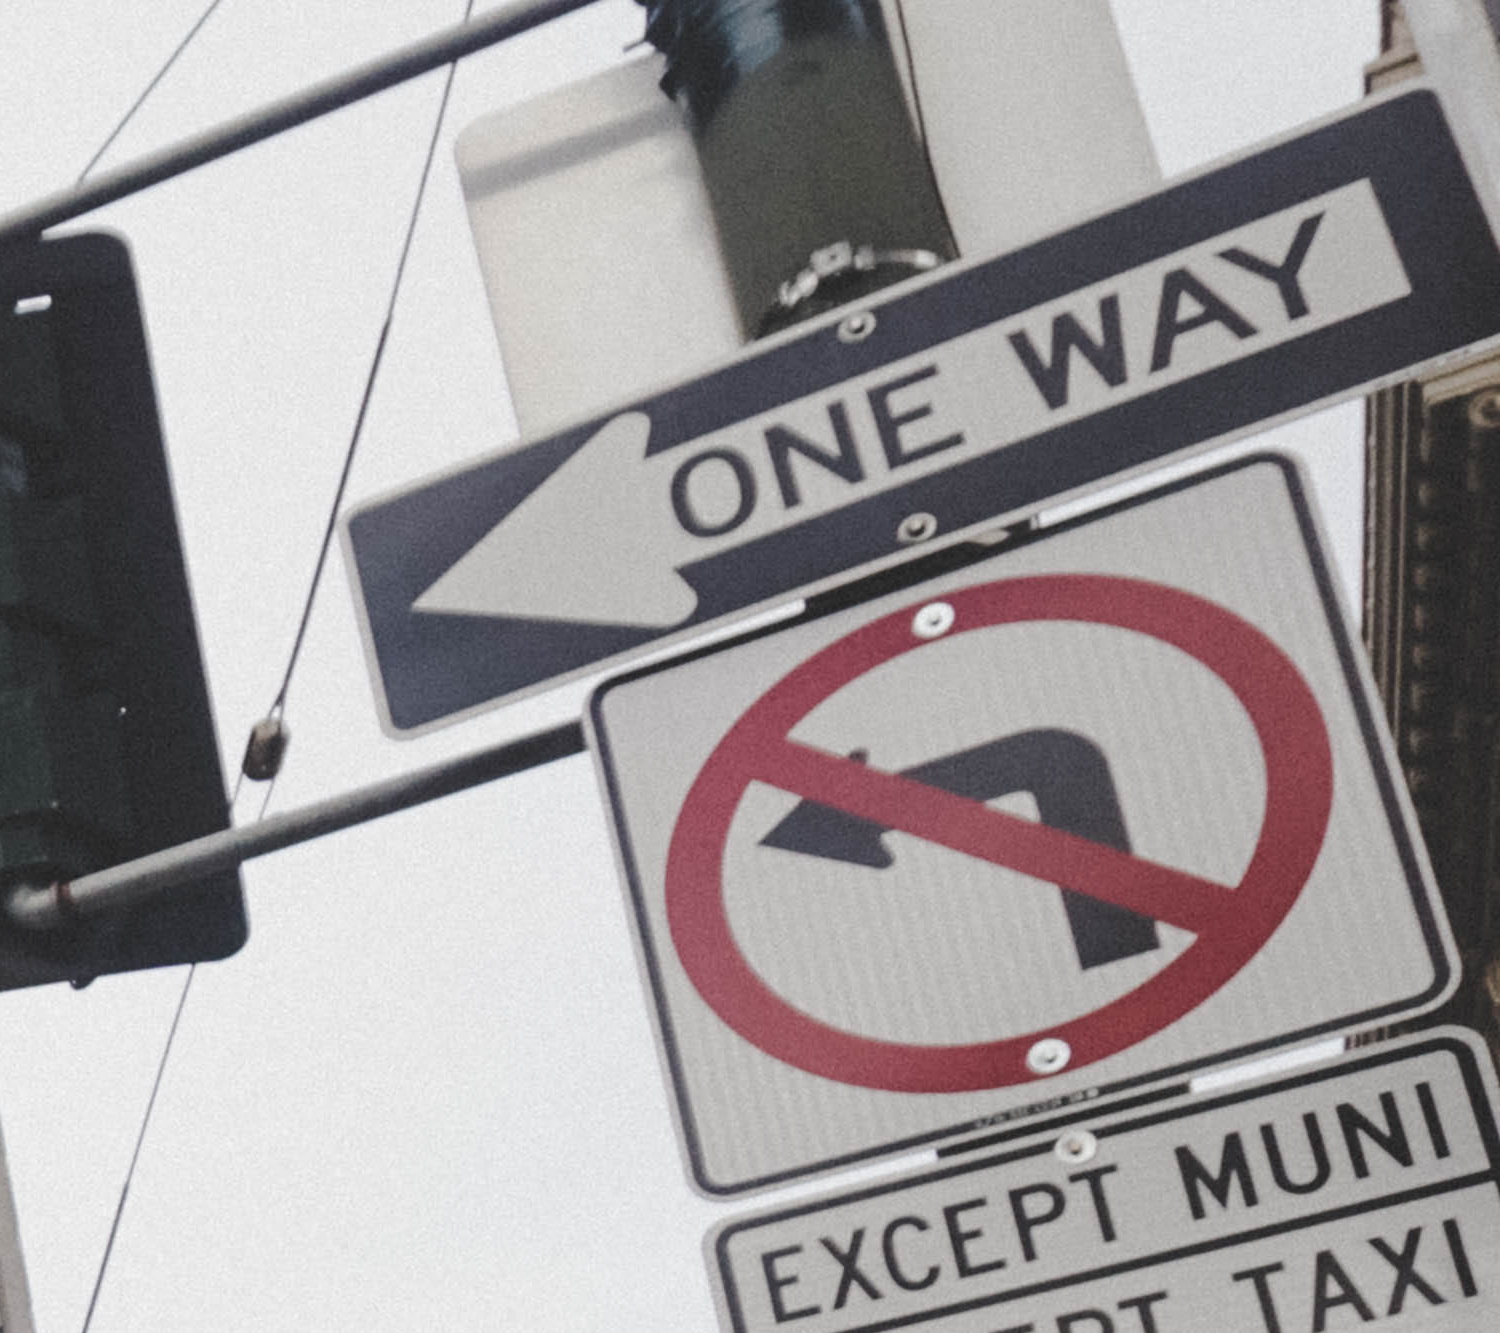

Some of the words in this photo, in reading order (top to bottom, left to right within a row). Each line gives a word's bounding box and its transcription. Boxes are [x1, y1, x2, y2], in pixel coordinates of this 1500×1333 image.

[671, 366, 966, 540] ONE
[1008, 212, 1329, 411] WAY
[761, 1164, 1120, 1323] EXCEPT
[1175, 1081, 1452, 1220] MUNI
